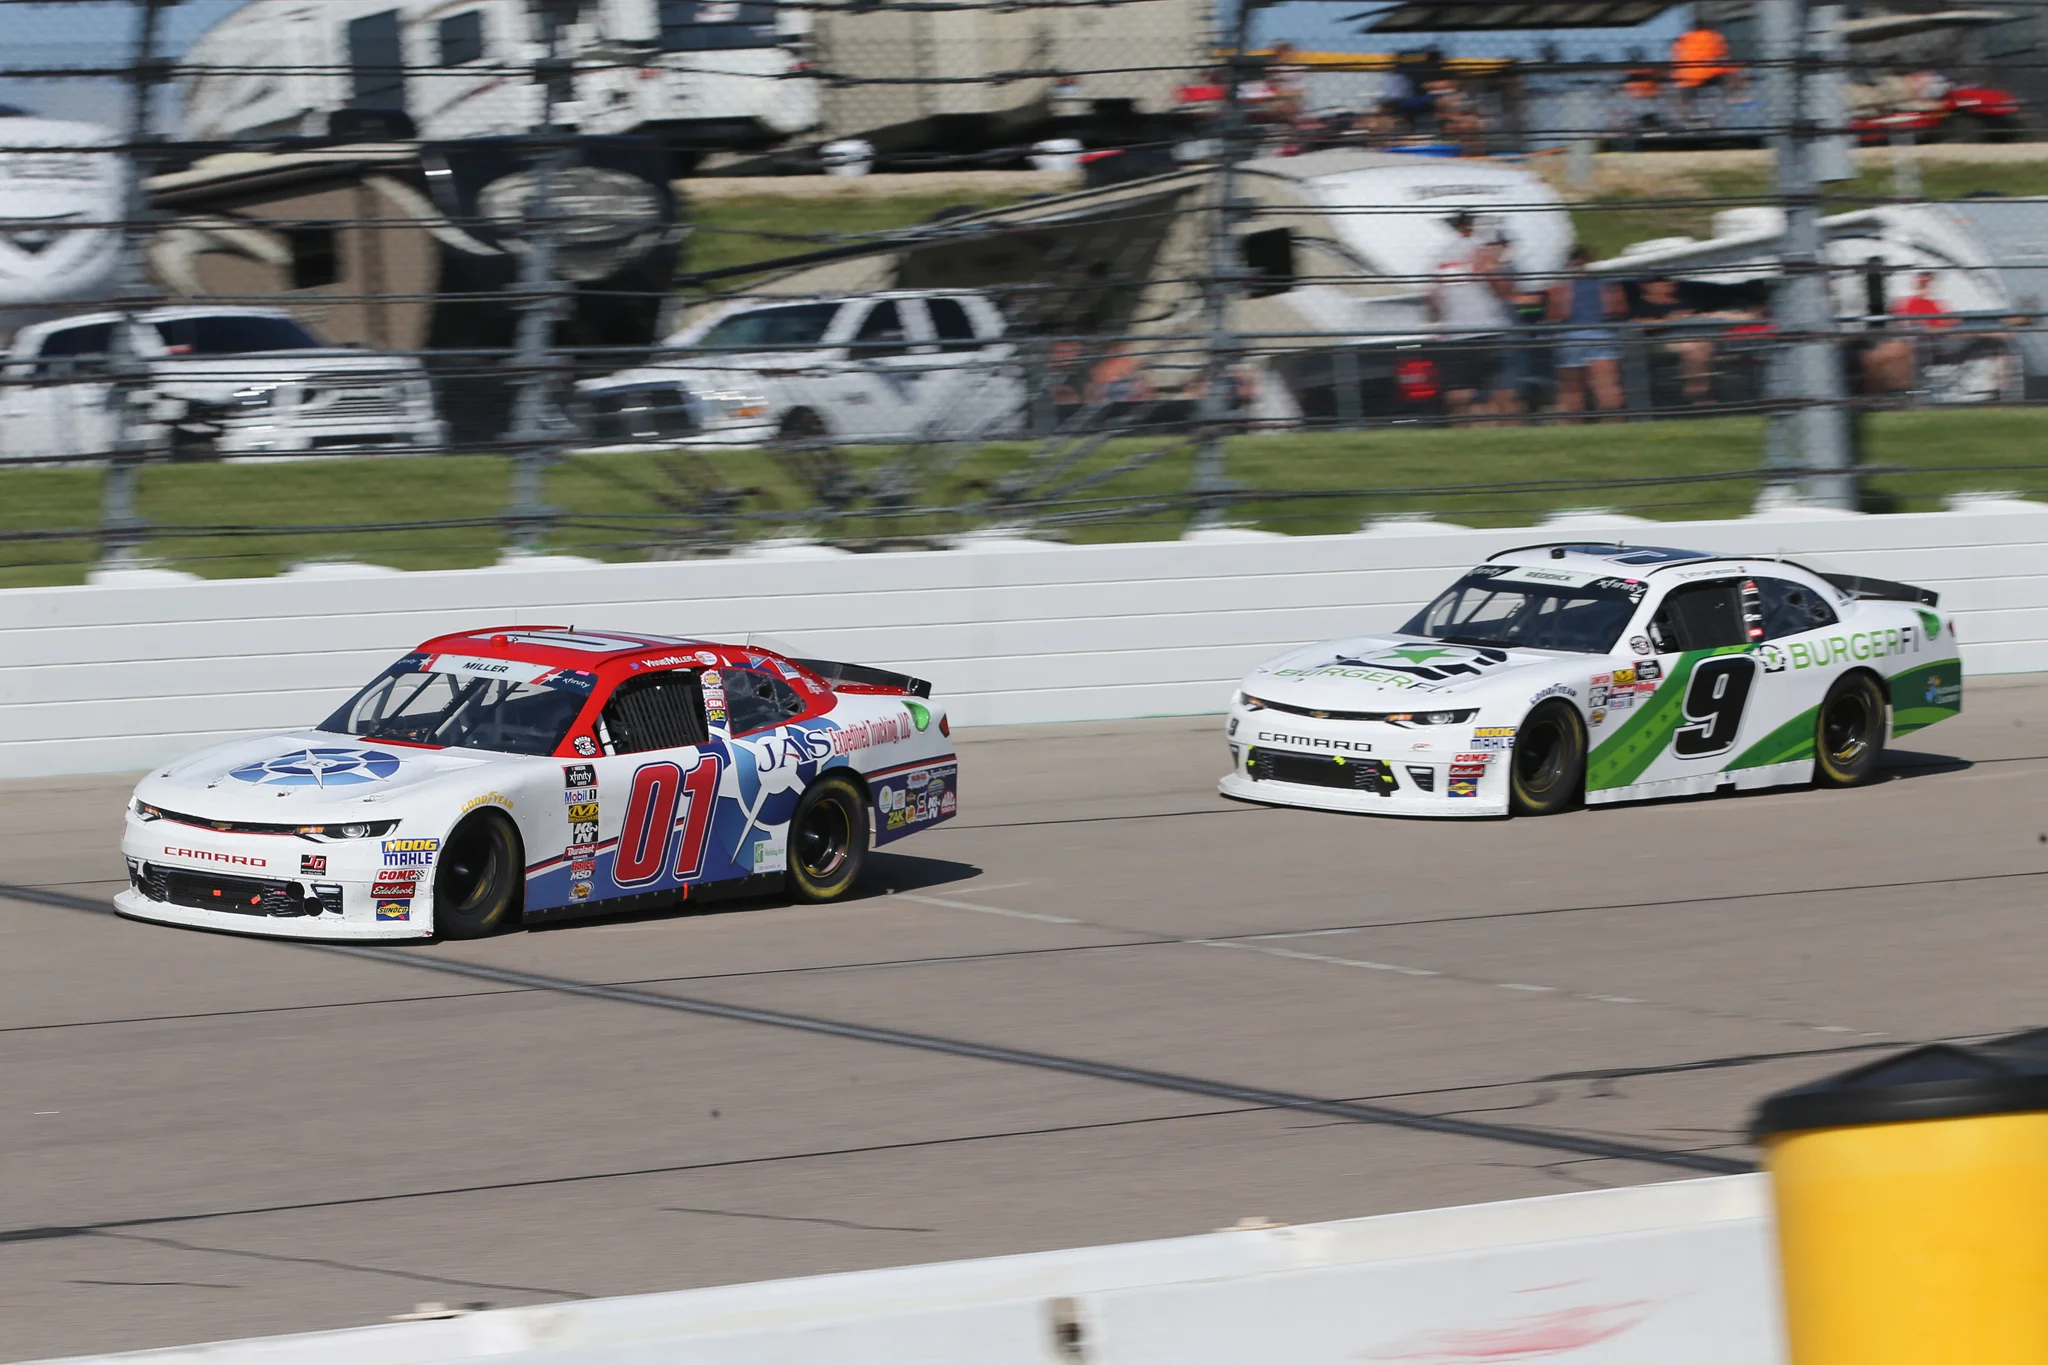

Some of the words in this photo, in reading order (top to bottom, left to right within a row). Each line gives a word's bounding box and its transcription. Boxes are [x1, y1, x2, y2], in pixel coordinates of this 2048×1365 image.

[1525, 571, 1574, 583] REDDICK
[1597, 579, 1647, 594] xfinity
[1788, 626, 1920, 670] BURGERFI
[463, 662, 509, 674] MILLER
[562, 677, 591, 689] xfinity
[1273, 667, 1445, 693] BURGERFI
[1670, 653, 1760, 761] 9
[829, 720, 870, 755] Expedited
[866, 716, 899, 746] Trucking,
[896, 711, 911, 740] LLC
[1228, 718, 1239, 736] 9
[1475, 727, 1516, 737] MOOG
[1258, 731, 1372, 753] CAMARO
[758, 731, 831, 772] JAS
[569, 770, 592, 784] xfinity
[565, 790, 588, 803] Mobil
[611, 752, 724, 889] 01
[888, 809, 905, 824] ZAK
[384, 839, 438, 853] MOOG
[567, 845, 595, 856] Duralast
[164, 846, 266, 867] CAMARO
[383, 852, 433, 866] MAHLE
[378, 870, 416, 881] COMP
[570, 870, 592, 881] MSD
[372, 886, 414, 895] Edelbrock
[378, 906, 408, 914] SUNOCO
